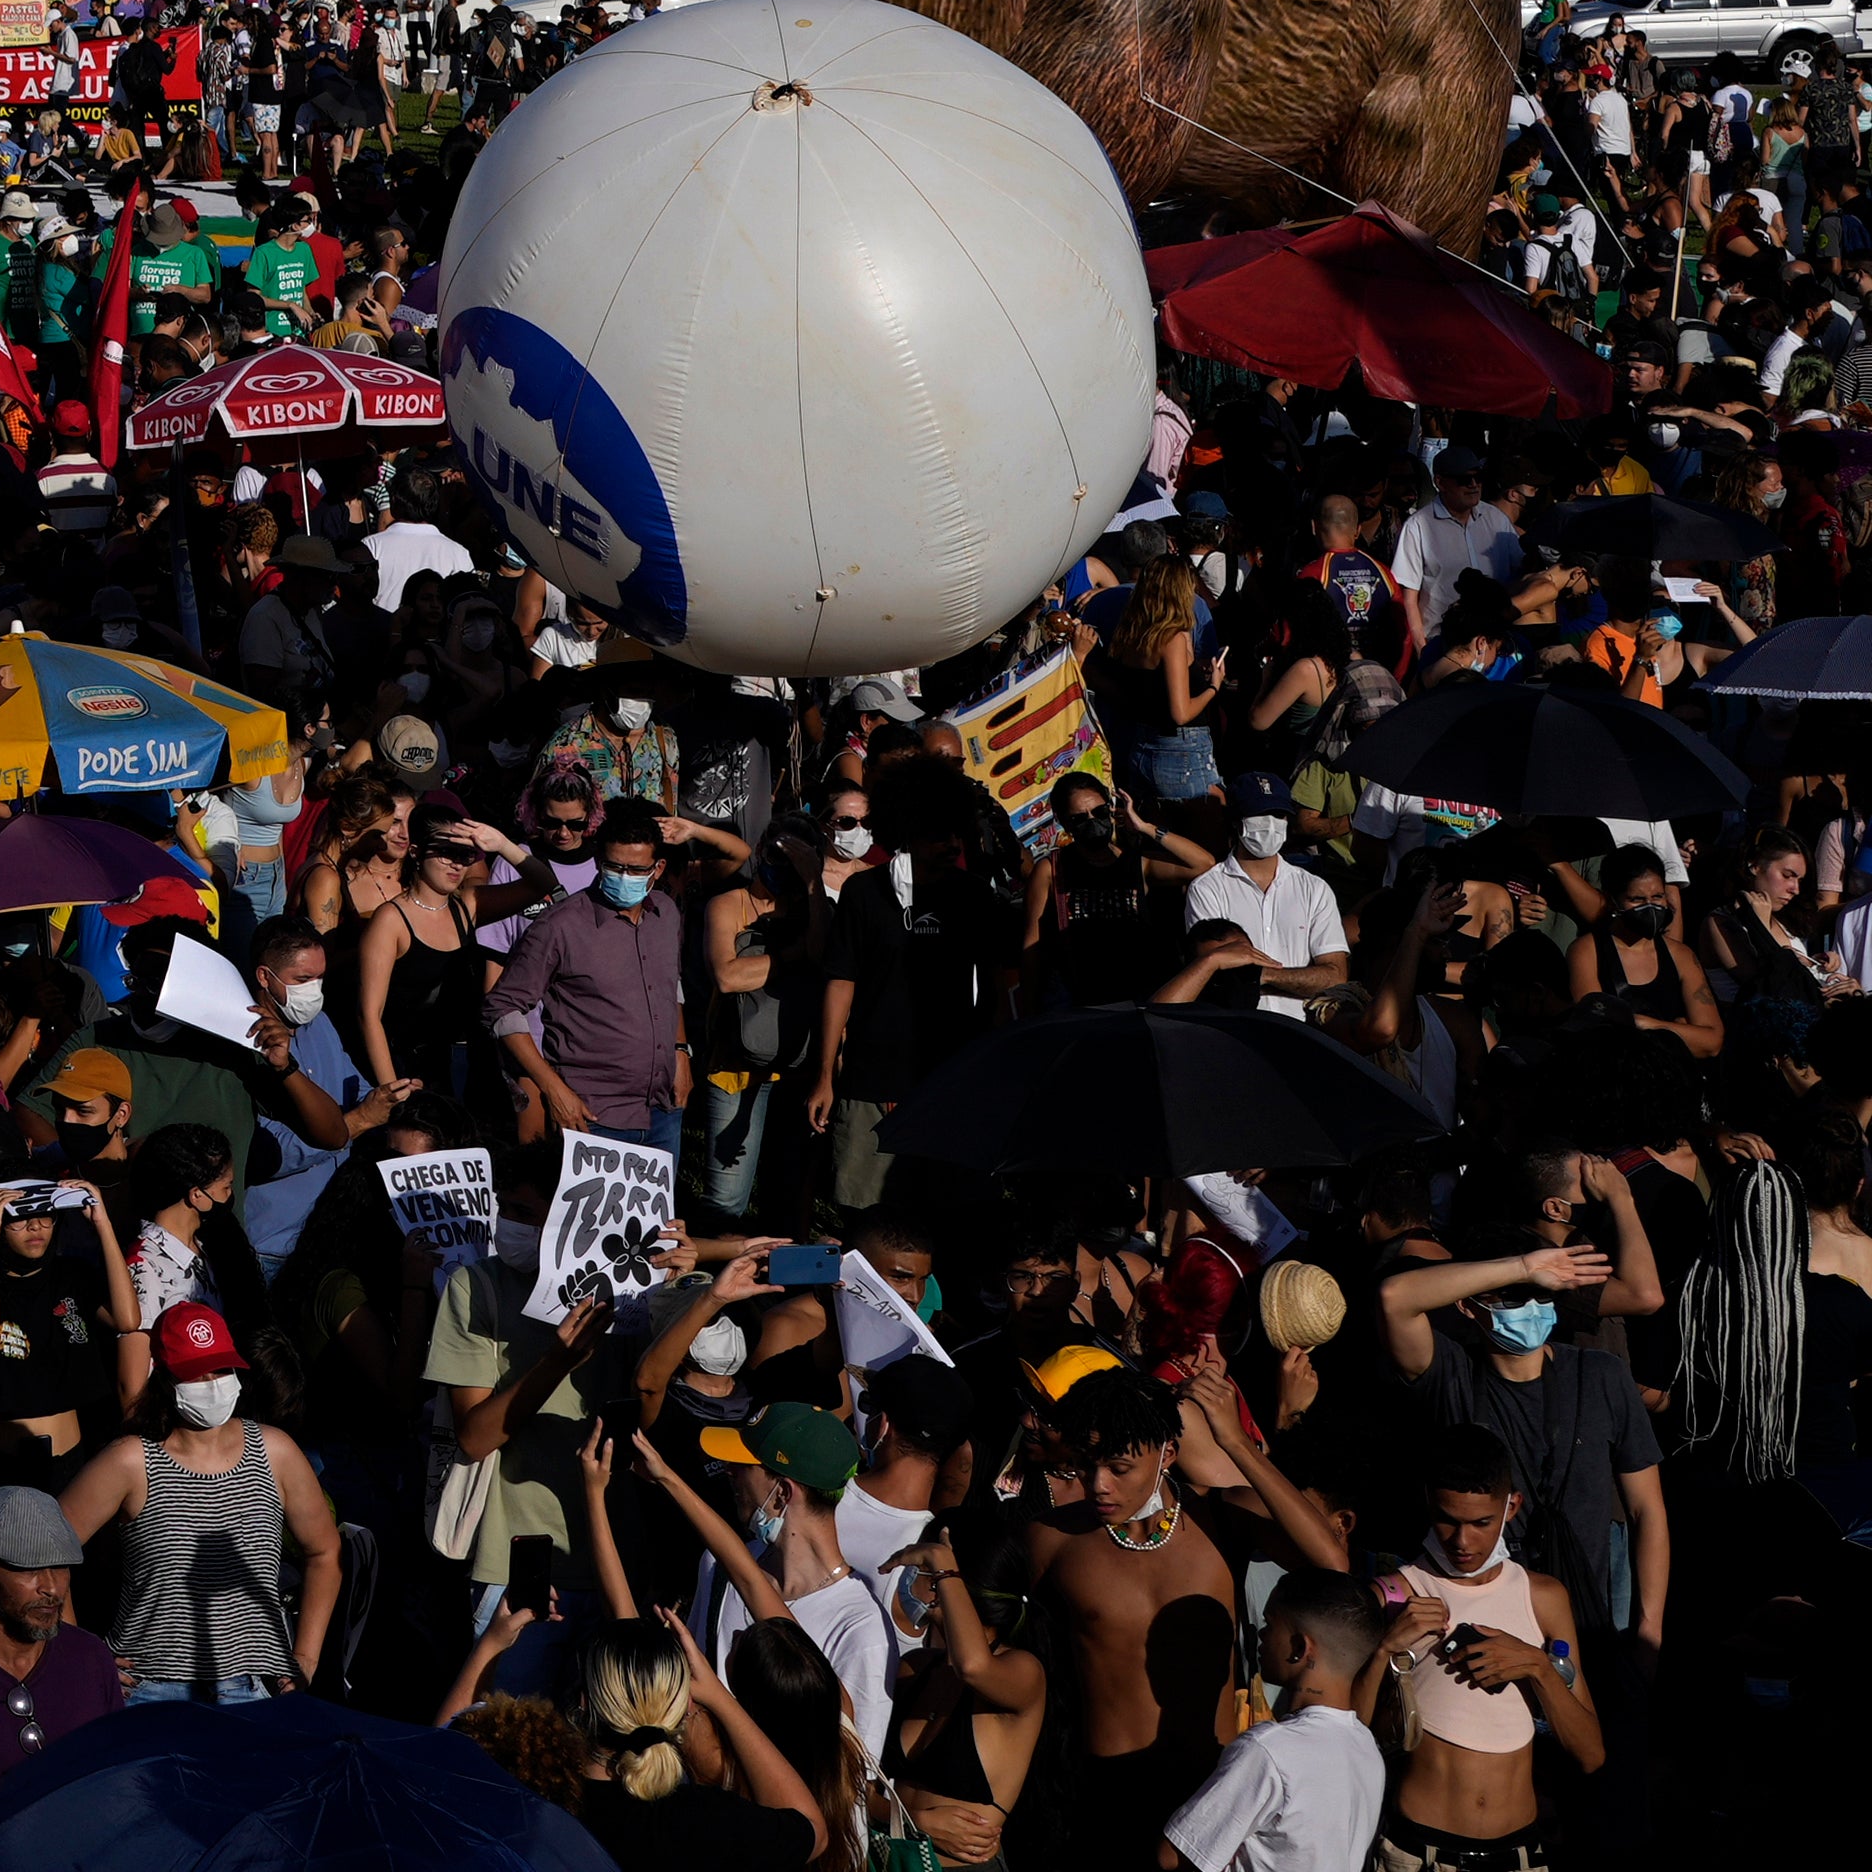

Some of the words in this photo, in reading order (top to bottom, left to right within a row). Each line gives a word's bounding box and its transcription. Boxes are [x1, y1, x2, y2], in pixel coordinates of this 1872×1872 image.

[2, 5, 39, 14] PASTEL
[0, 49, 96, 71] TERA
[247, 400, 326, 426] KIBON
[375, 394, 437, 415] KIBON
[144, 414, 197, 441] KIBON
[472, 421, 611, 568] UNE
[82, 697, 141, 713] Nestlé
[78, 744, 140, 781] PODE
[148, 739, 188, 776] SIM
[390, 1161, 460, 1192] CHEGA
[461, 1159, 487, 1183] DE
[572, 1140, 621, 1177] ATO
[622, 1151, 671, 1193] PELA
[395, 1186, 492, 1224] VENENO
[555, 1176, 672, 1270] TERRA
